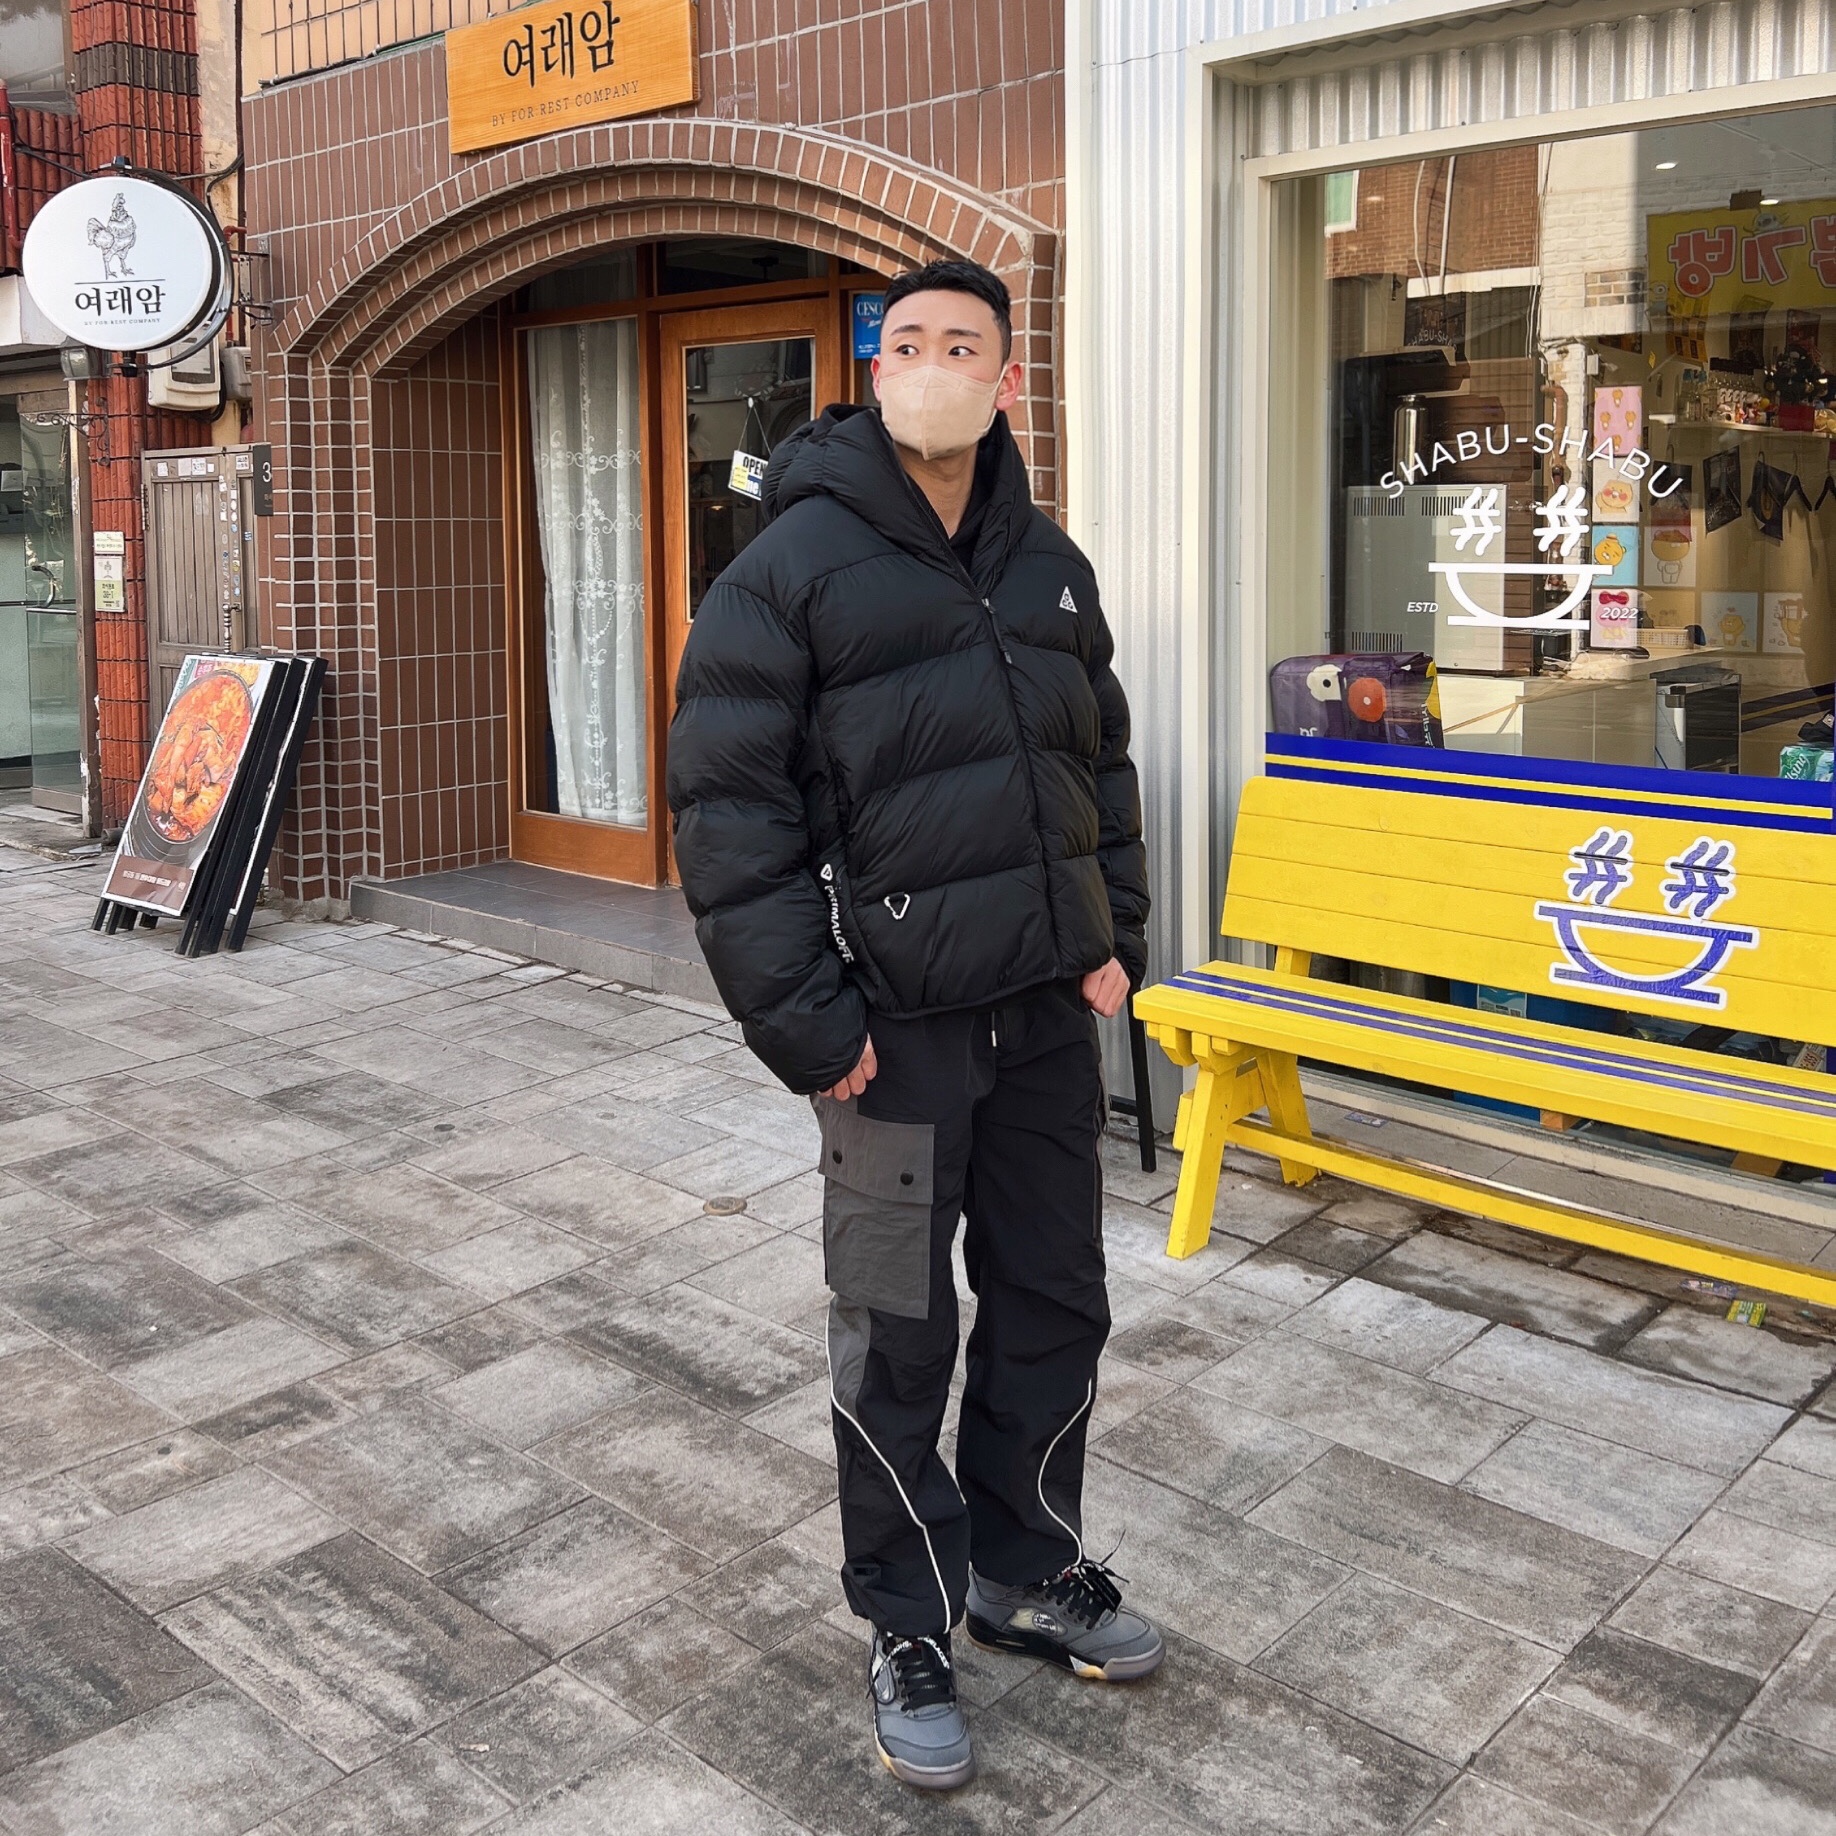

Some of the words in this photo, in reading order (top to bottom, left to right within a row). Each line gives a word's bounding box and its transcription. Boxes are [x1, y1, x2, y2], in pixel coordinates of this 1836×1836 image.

[503, 0, 621, 88] 여래암
[492, 112, 507, 127] BY
[575, 80, 640, 108] COMPANY
[75, 285, 166, 316] 여래암
[1379, 423, 1684, 499] SHABU-SHABU
[1406, 602, 1439, 613] ESTD
[1600, 607, 1639, 620] 2022
